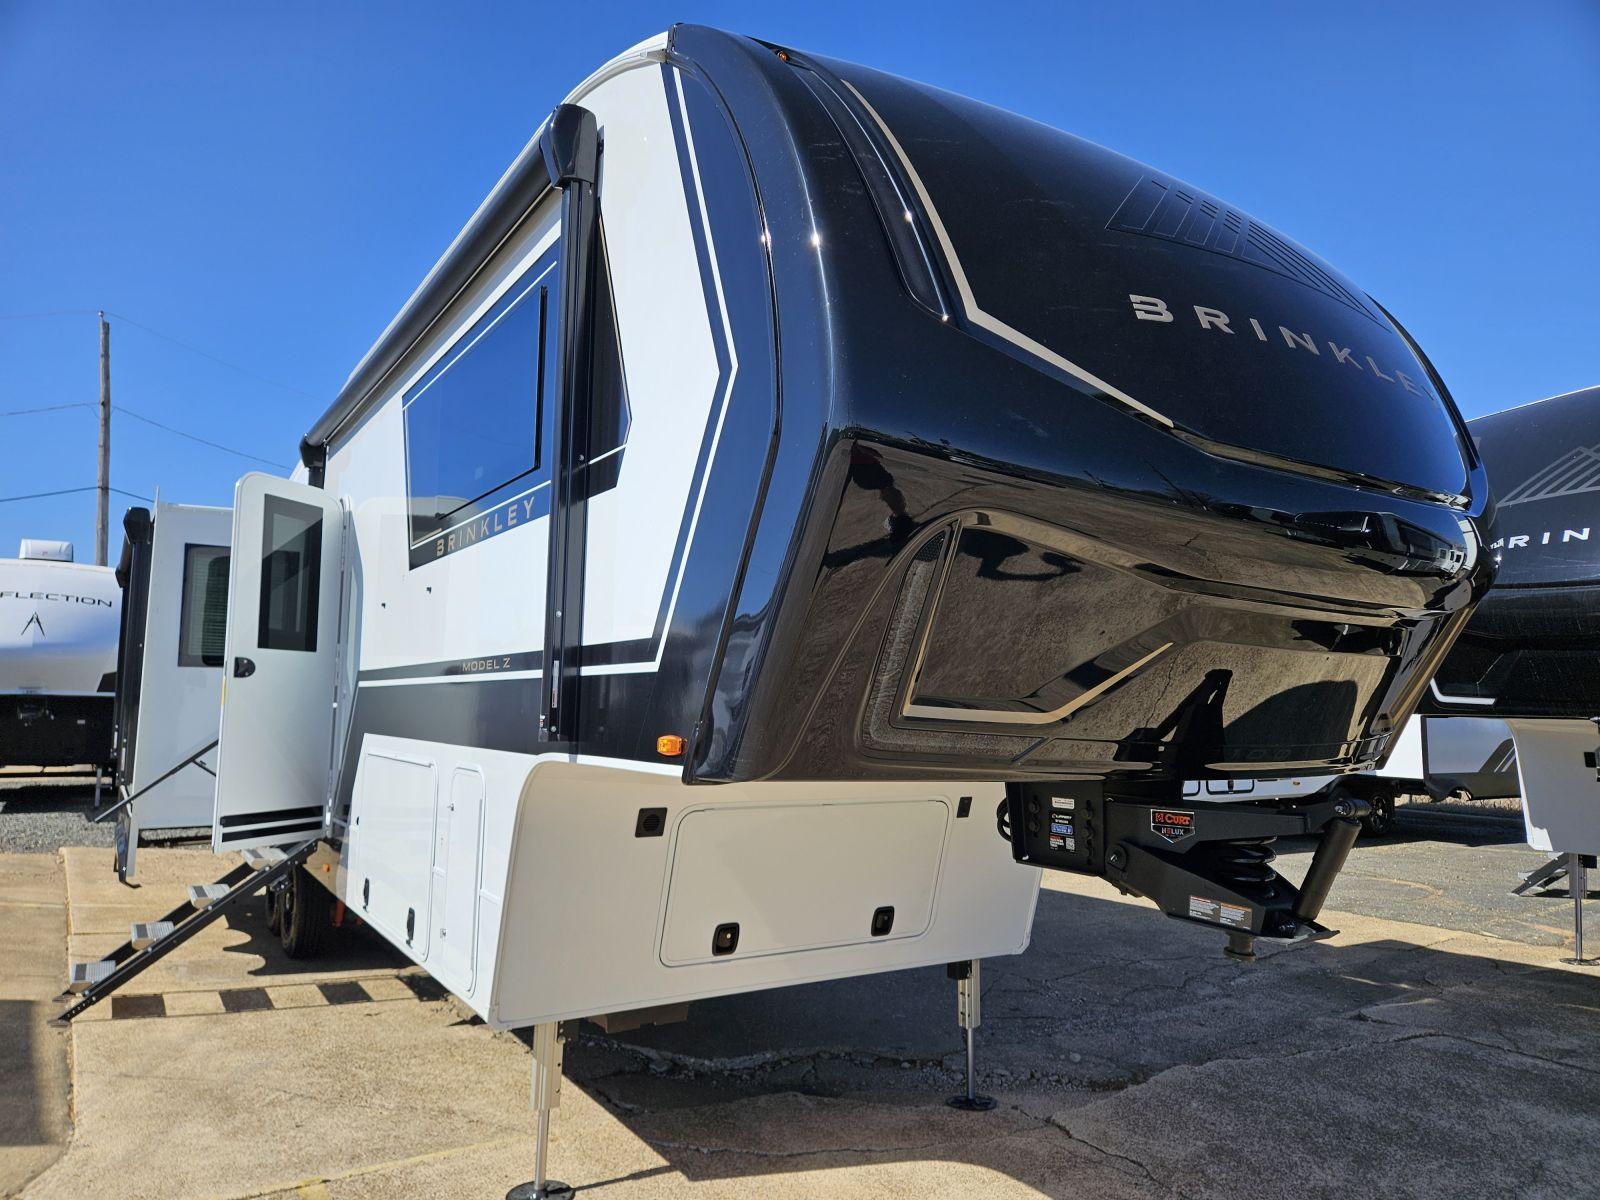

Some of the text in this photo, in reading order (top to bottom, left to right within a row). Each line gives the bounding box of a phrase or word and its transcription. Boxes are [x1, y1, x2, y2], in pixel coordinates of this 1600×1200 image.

[436, 497, 535, 556] BRINKLEY
[462, 657, 511, 672] MODEL Z
